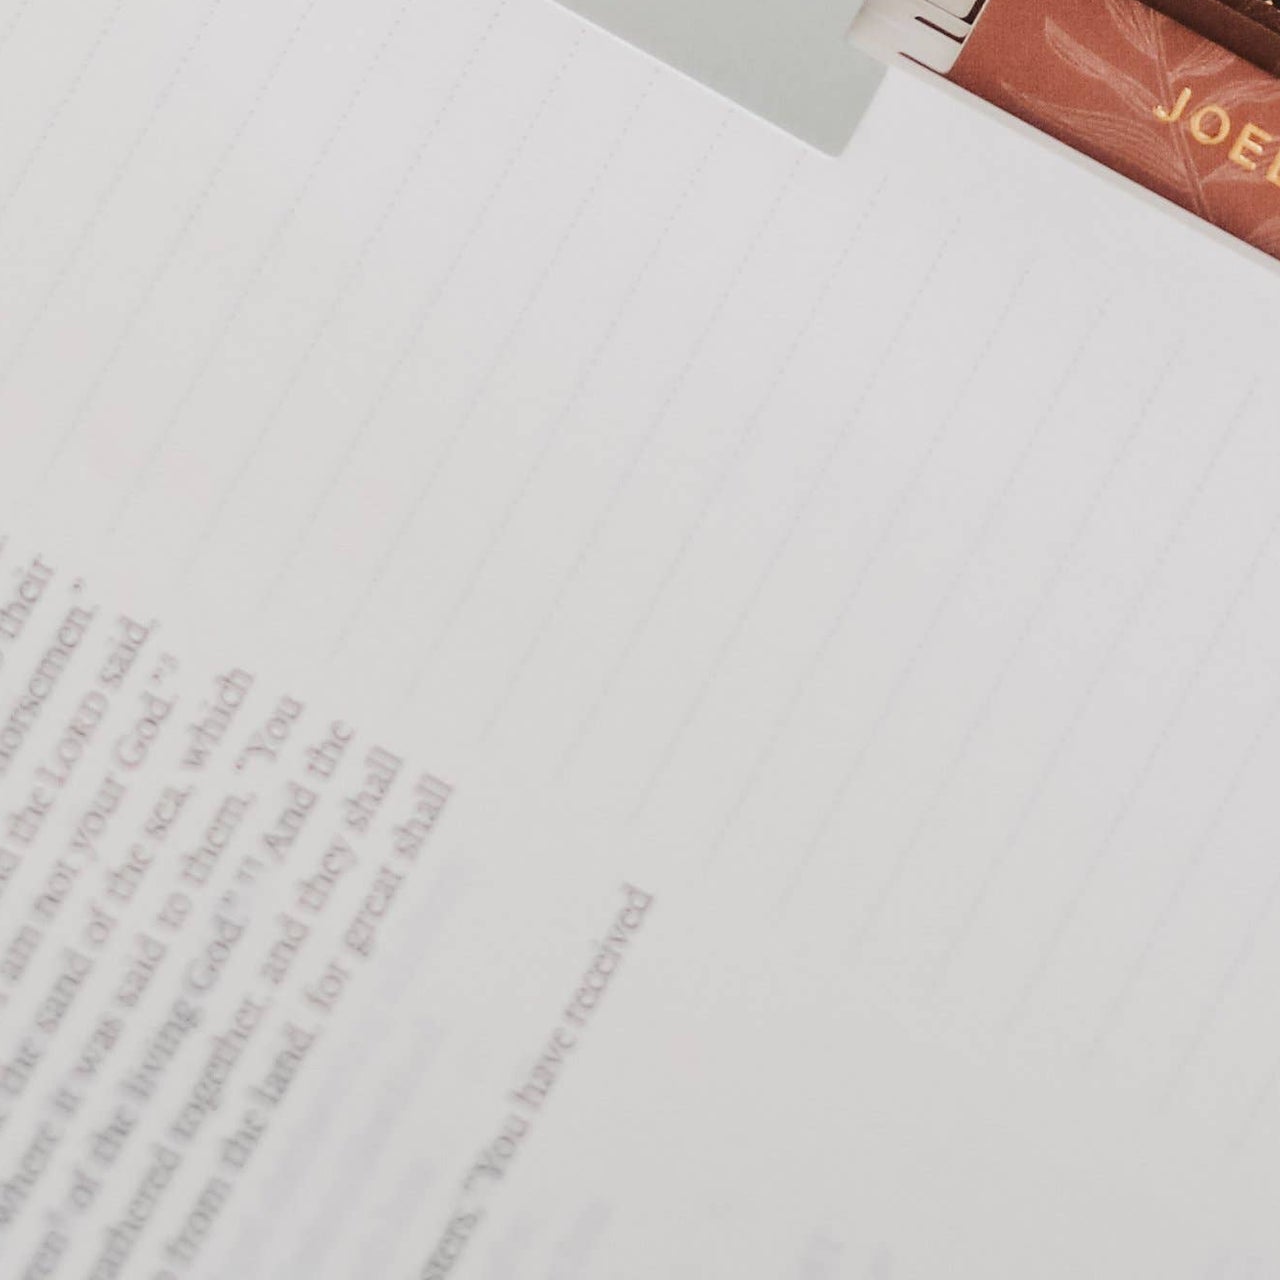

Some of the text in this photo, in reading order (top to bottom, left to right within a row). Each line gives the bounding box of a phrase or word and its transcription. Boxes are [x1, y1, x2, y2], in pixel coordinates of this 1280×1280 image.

[176, 662, 255, 772] which
[257, 780, 319, 862] And
[301, 716, 356, 782] the
[337, 743, 404, 835] shall
[558, 881, 655, 1029] received
